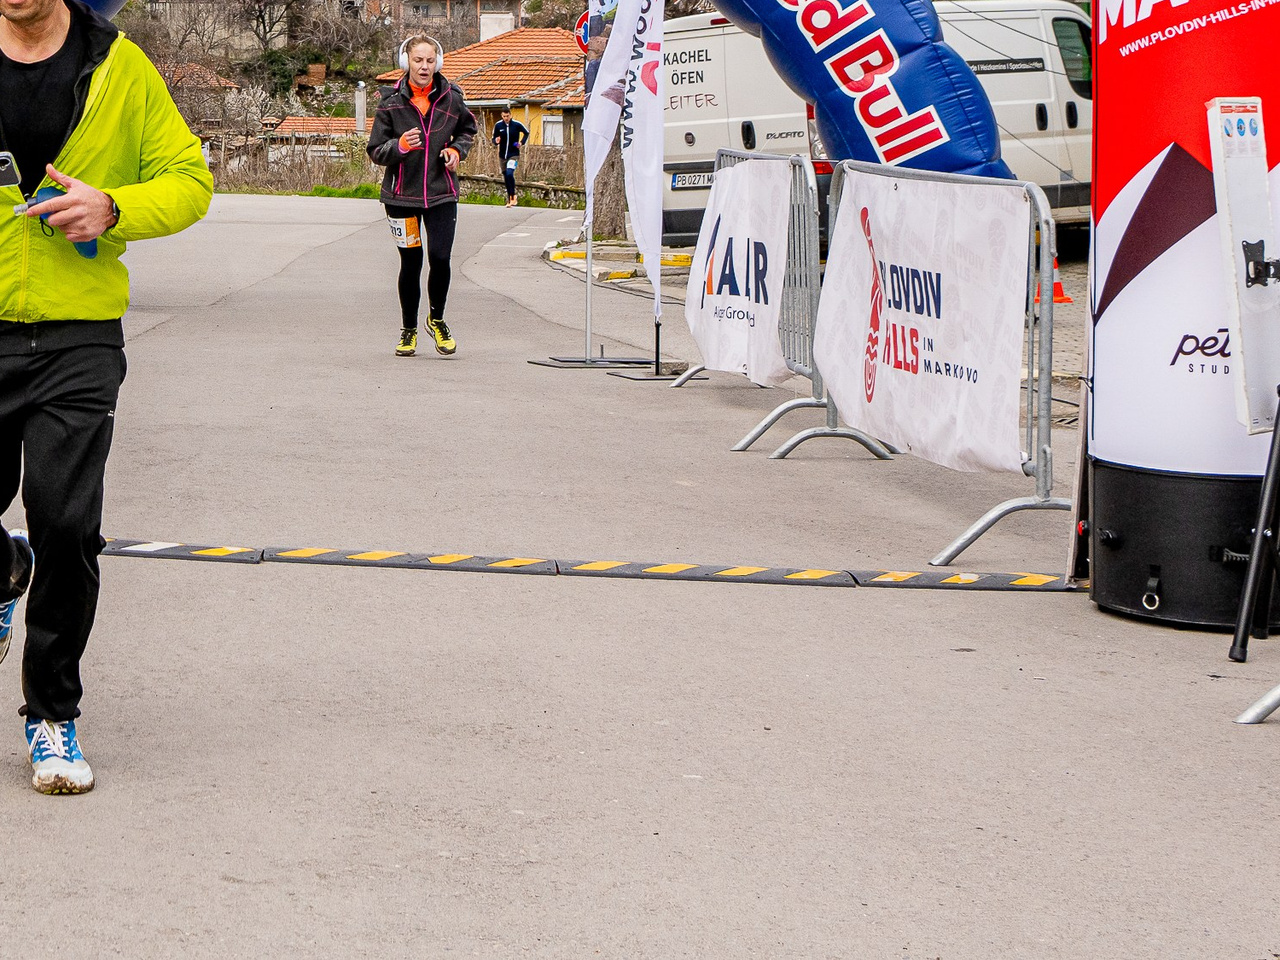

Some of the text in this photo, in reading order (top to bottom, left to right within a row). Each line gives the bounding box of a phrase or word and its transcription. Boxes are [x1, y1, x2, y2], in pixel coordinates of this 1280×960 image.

[664, 49, 712, 66] KACHEL
[671, 69, 704, 85] ÖFEN
[827, 31, 947, 165] Bull
[766, 130, 805, 140] DUCATO
[687, 173, 707, 185] 0271
[923, 336, 934, 353] IN
[923, 359, 978, 384] MARKOVO
[1188, 362, 1231, 375] STUD
